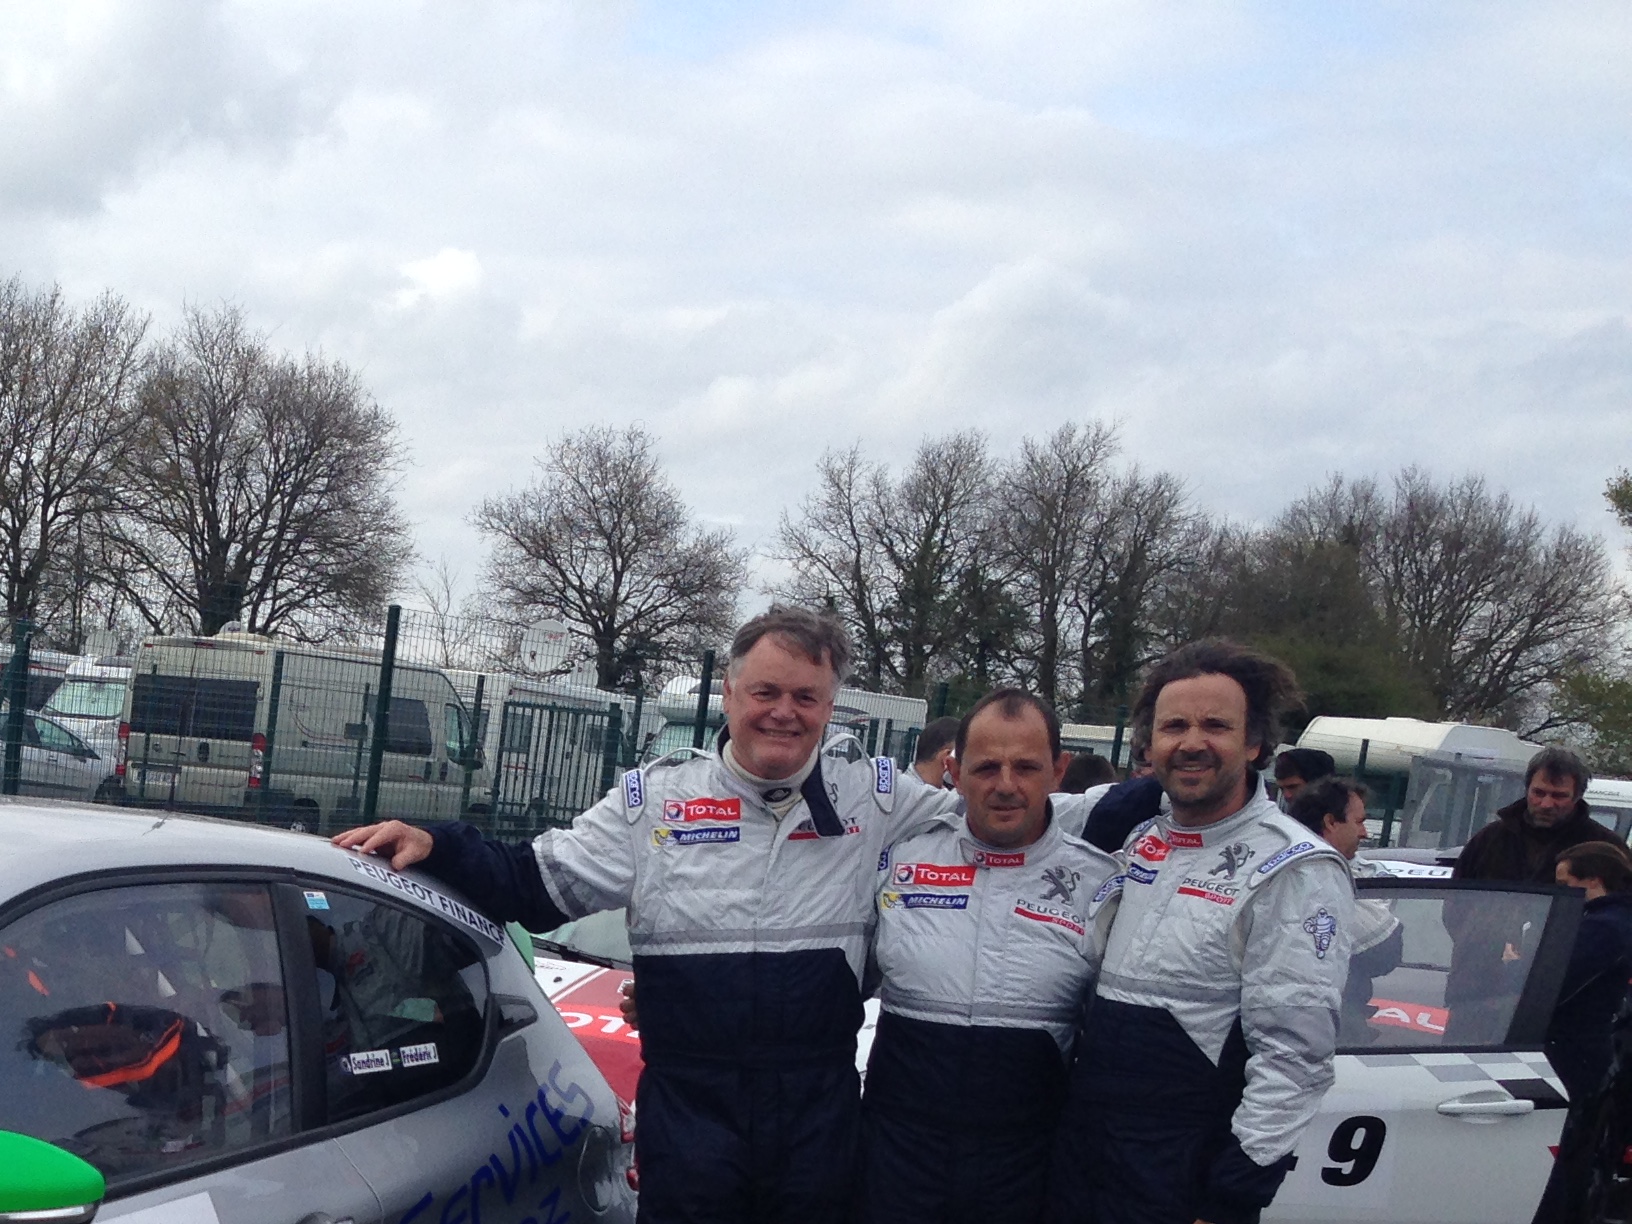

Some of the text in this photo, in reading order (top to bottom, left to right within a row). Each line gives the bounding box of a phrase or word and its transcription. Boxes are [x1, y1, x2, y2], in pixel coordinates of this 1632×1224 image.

[686, 804, 738, 817] TOTAL
[679, 830, 739, 841] MICHELIN
[987, 857, 1024, 866] TOTAL
[917, 867, 972, 883] TOTAL
[1182, 878, 1240, 896] PEUGEOT
[349, 857, 506, 946] PEUGEOT FINANCE
[907, 896, 967, 906] MICHELIN
